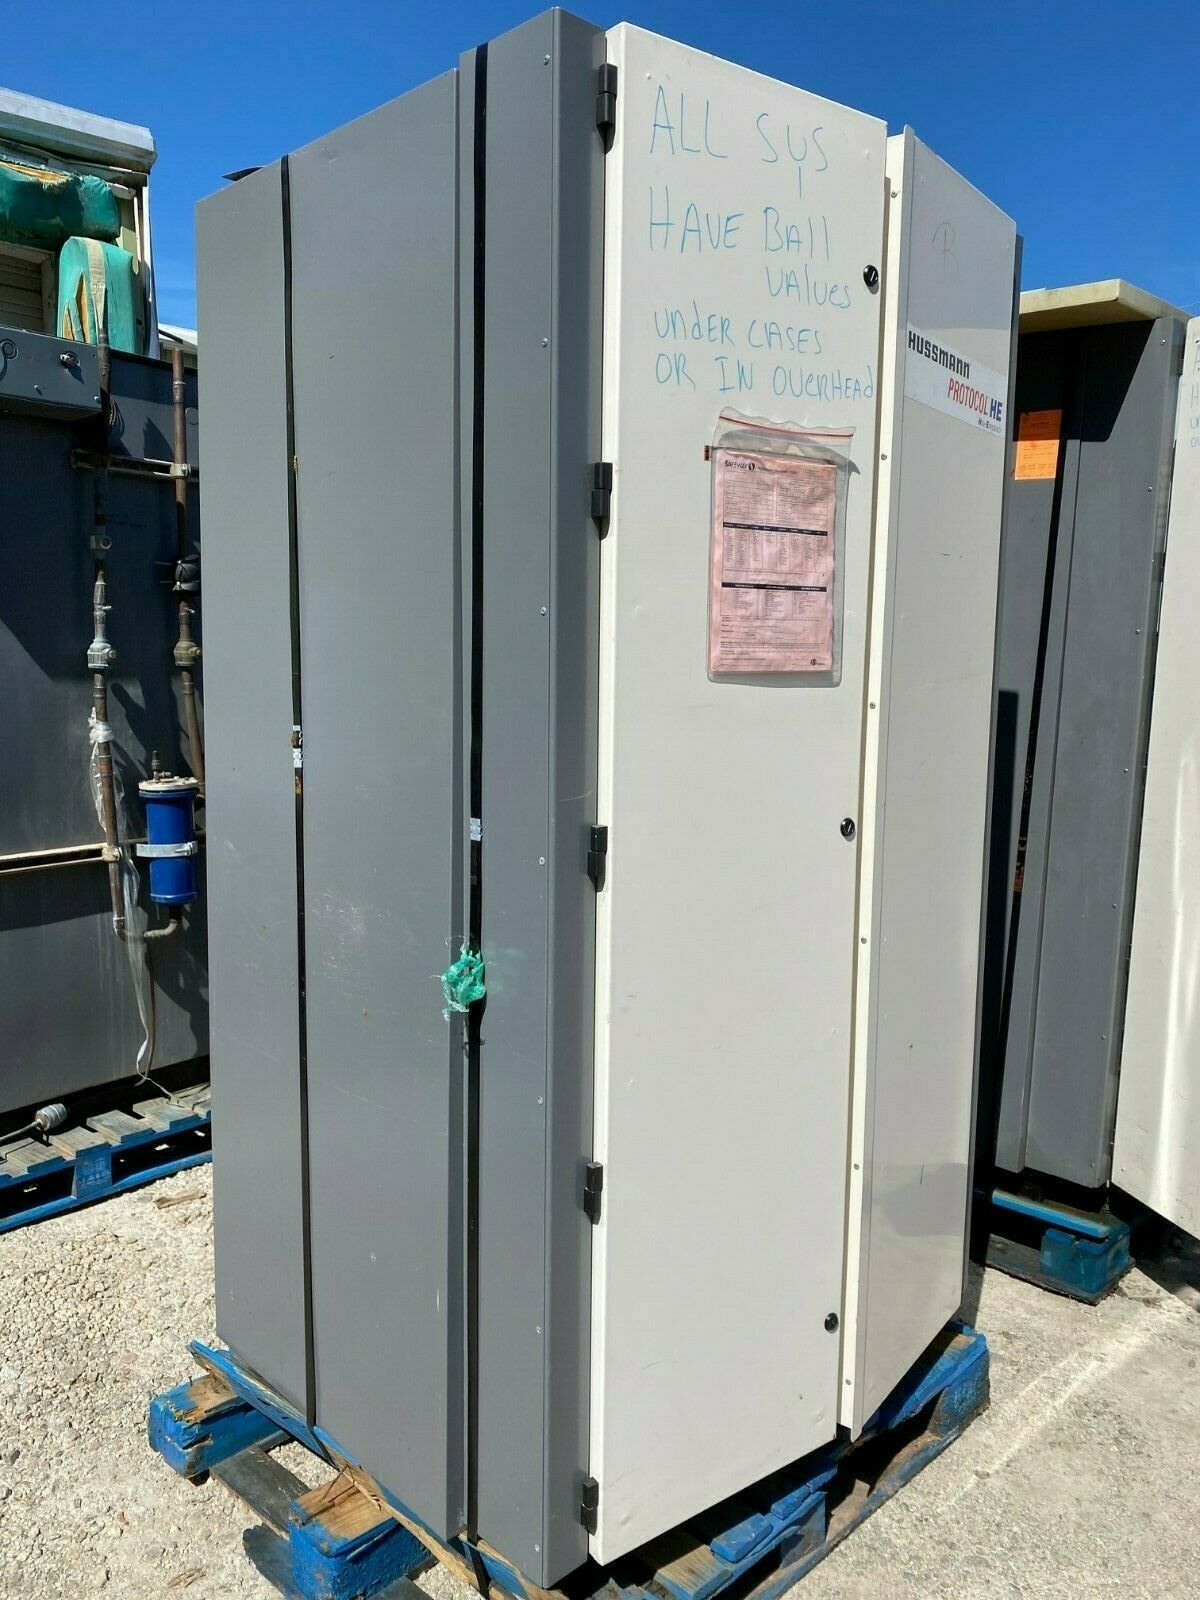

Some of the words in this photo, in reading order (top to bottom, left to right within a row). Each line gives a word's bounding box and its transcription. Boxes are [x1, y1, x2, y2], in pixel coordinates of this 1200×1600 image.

[649, 84, 728, 159] ALL
[649, 185, 745, 254] HAVE
[748, 319, 823, 355] CASES
[907, 330, 970, 380] HUSSMANN
[655, 353, 696, 389] OR
[715, 356, 754, 395] IN
[947, 378, 988, 416] PROTOCOL
[989, 398, 1003, 422] HE
